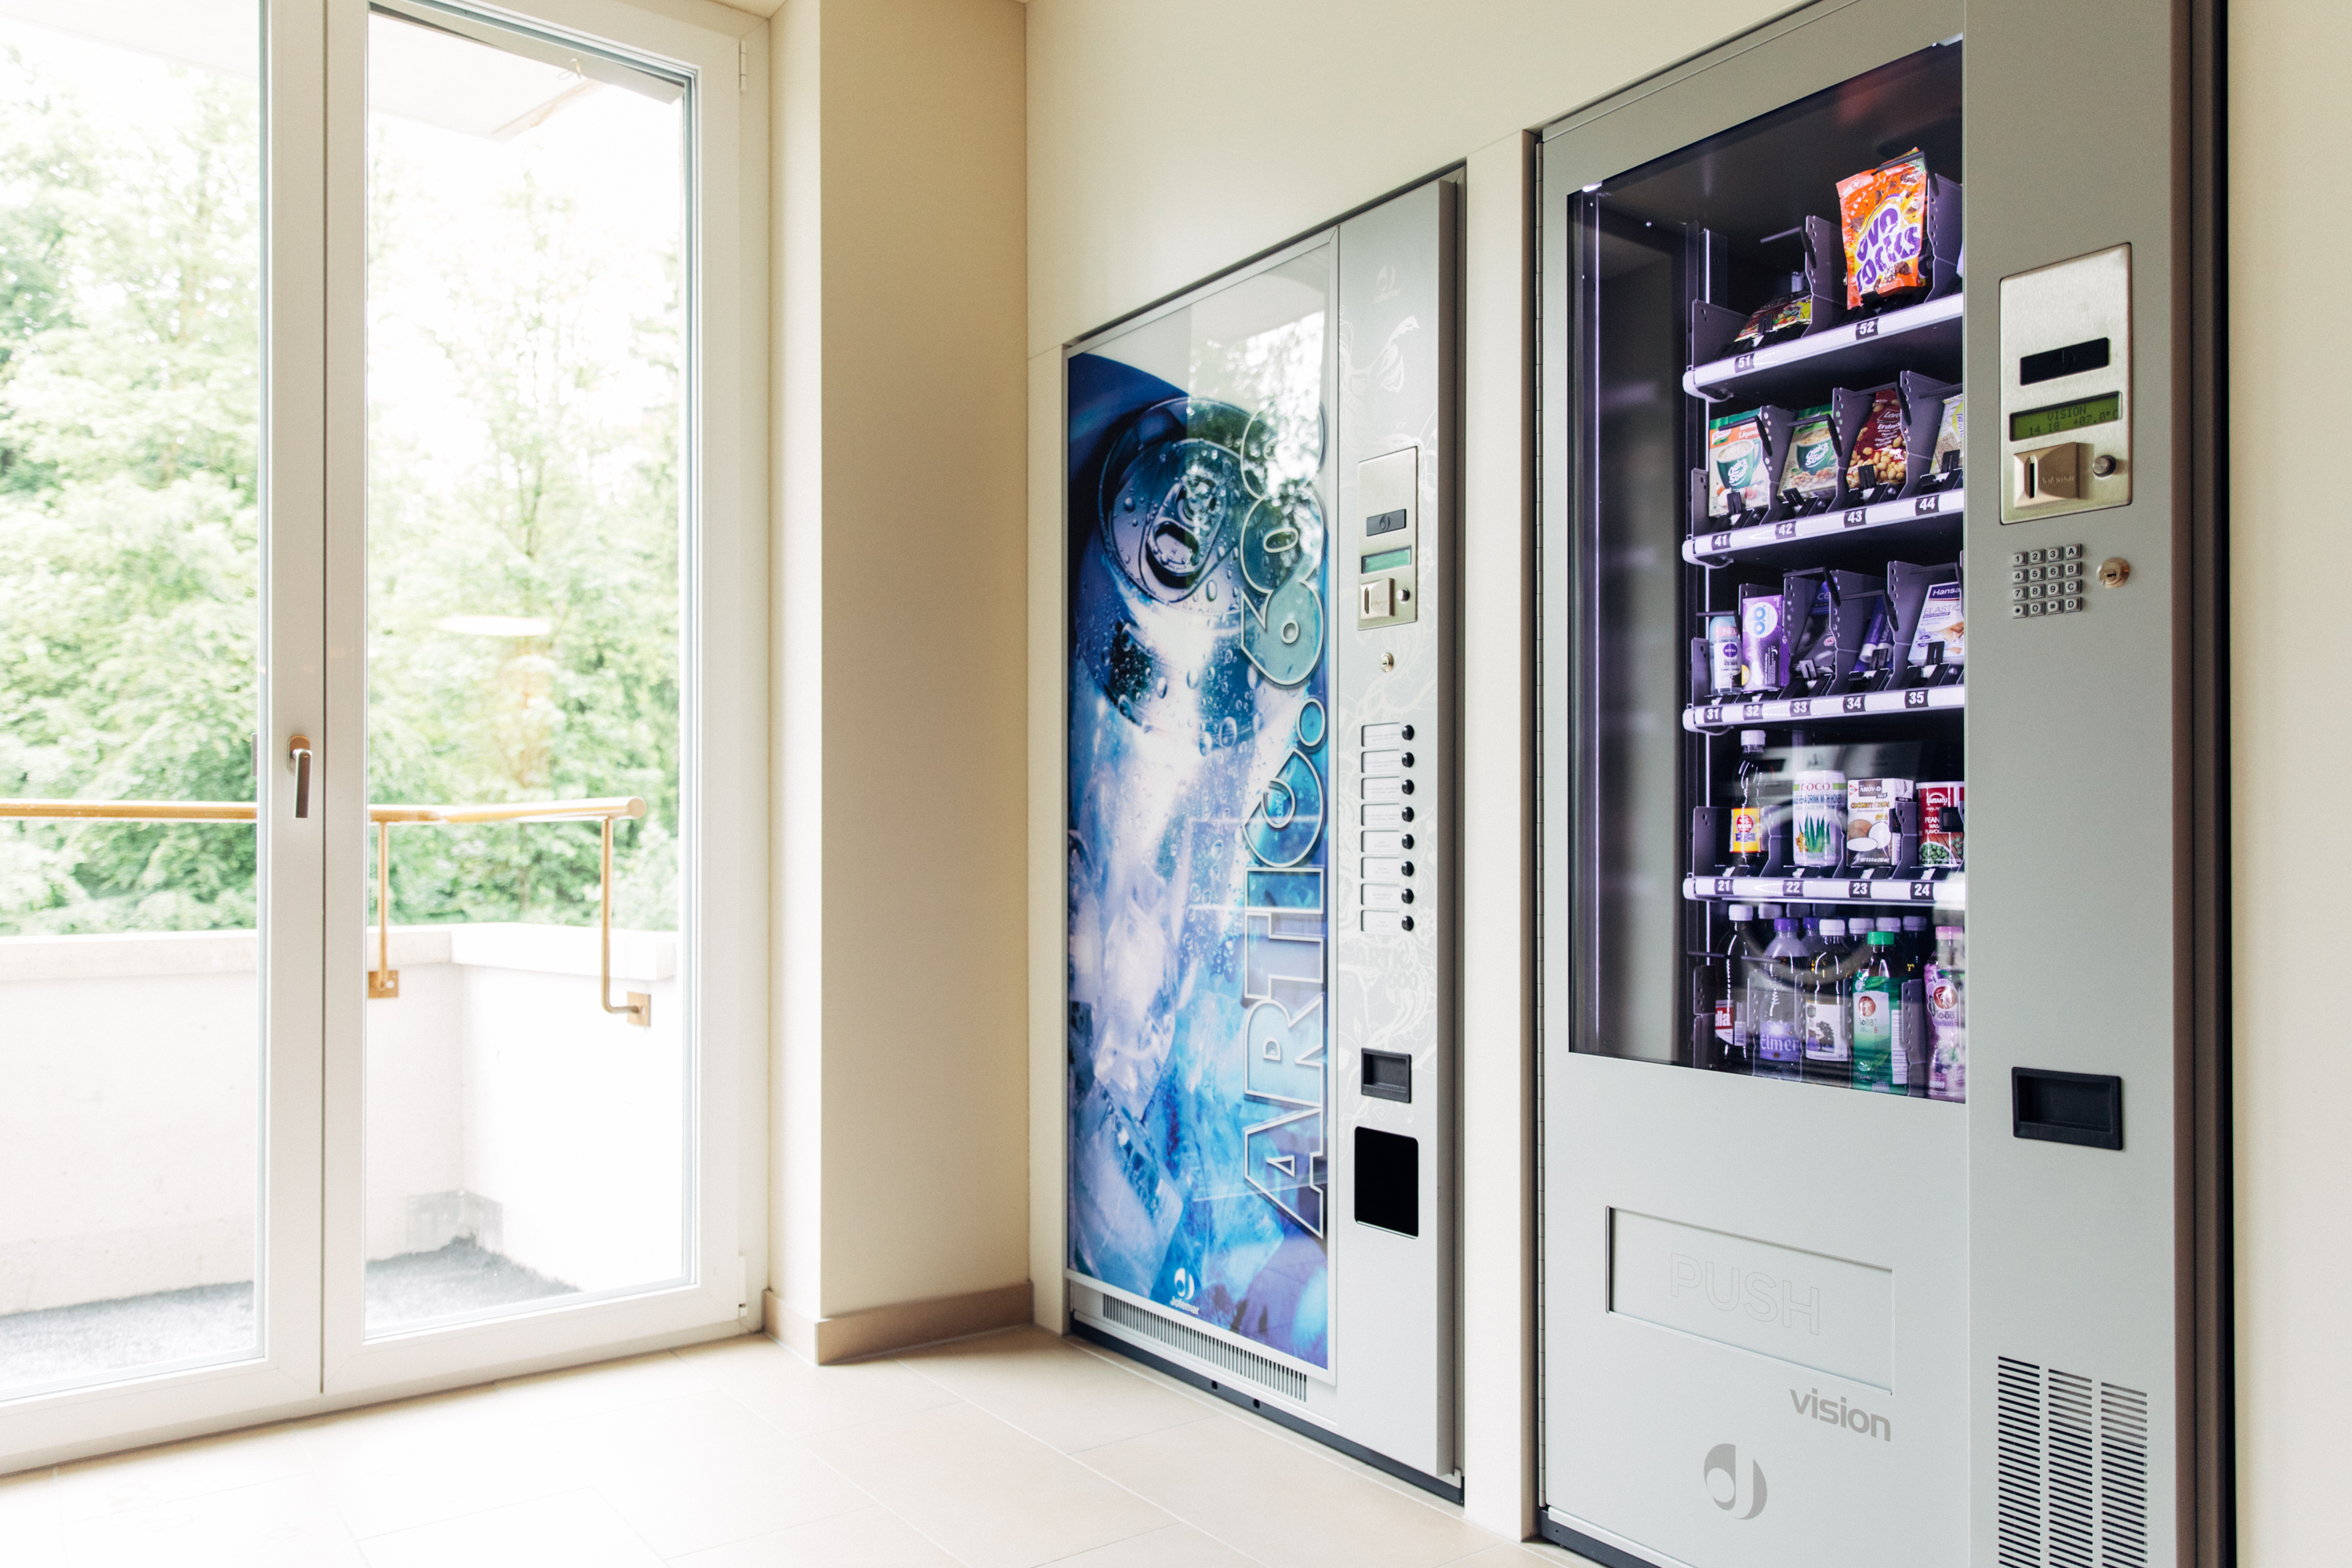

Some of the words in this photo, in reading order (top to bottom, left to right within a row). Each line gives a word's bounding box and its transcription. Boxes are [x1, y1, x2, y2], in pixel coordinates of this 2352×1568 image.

[1857, 207, 1898, 262] OVO
[1737, 357, 1751, 368] 51
[1860, 322, 1874, 335] 52
[2047, 405, 2086, 422] VISION
[1806, 442, 1829, 460] Quick
[1728, 458, 1748, 477] Quick
[1715, 534, 1727, 546] 41
[1779, 523, 1793, 535] 42
[1848, 510, 1863, 523] 43
[1919, 497, 1936, 510] 44
[2068, 547, 2074, 556] A
[1933, 587, 1960, 597] Hansa
[1923, 604, 1960, 615] ELASTIC
[1750, 604, 1766, 636] o.b.
[1707, 708, 1719, 720] 31
[1746, 705, 1759, 717] 32
[1794, 701, 1807, 713] 33
[1846, 697, 1861, 710] 34
[1908, 691, 1925, 704] 35
[1801, 782, 1831, 791] FOCO
[1718, 880, 1730, 892] 21
[1787, 880, 1800, 894] 22
[1853, 882, 1867, 895] 23
[1915, 883, 1930, 896] 24
[1387, 969, 1419, 991] 600
[1760, 1034, 1800, 1052] Elmer
[1670, 1251, 1820, 1336] PUSH
[1169, 1295, 1200, 1316] Jofemar
[1789, 1387, 1891, 1443] vision
